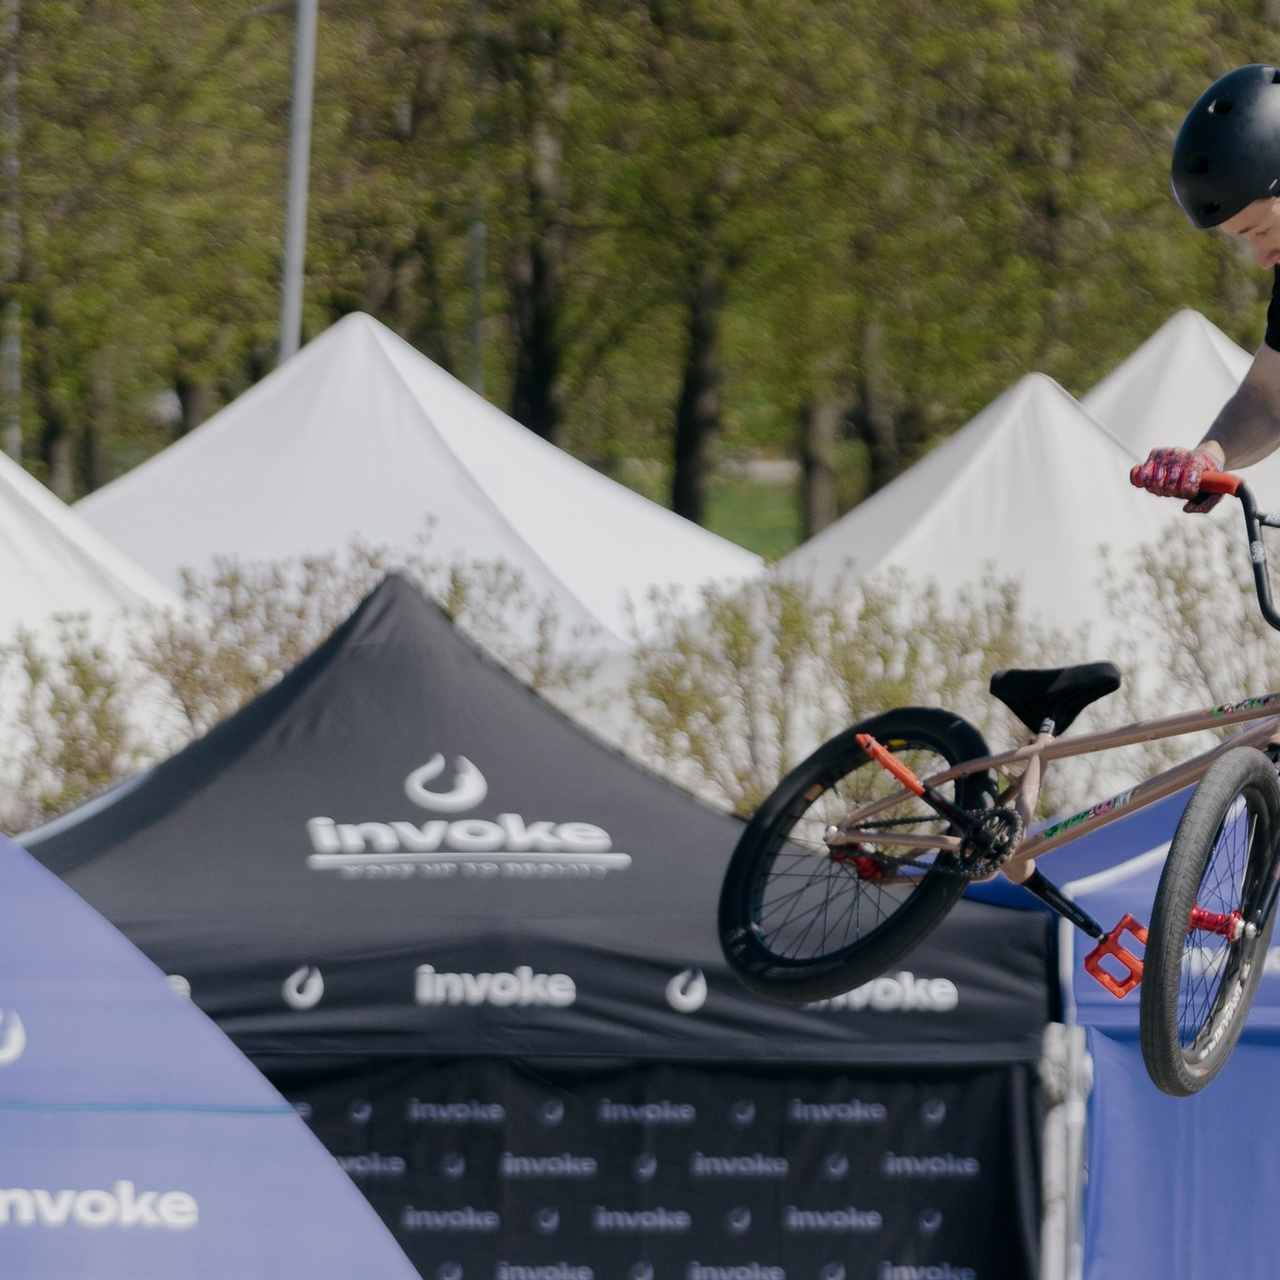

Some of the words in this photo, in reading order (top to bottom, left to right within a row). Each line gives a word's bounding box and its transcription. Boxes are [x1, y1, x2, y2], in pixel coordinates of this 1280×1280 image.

[307, 813, 613, 854] invoke
[414, 963, 577, 1007] invoke
[407, 1098, 505, 1124] invoke
[599, 1098, 696, 1124] invoke
[789, 1098, 887, 1124] invoke
[500, 1151, 598, 1178] invoke
[690, 1151, 789, 1178] invoke
[881, 1151, 980, 1178] invoke
[0, 1179, 199, 1228] nvoke
[402, 1205, 500, 1231] invoke
[593, 1205, 692, 1231] invoke
[785, 1205, 883, 1231] invoke
